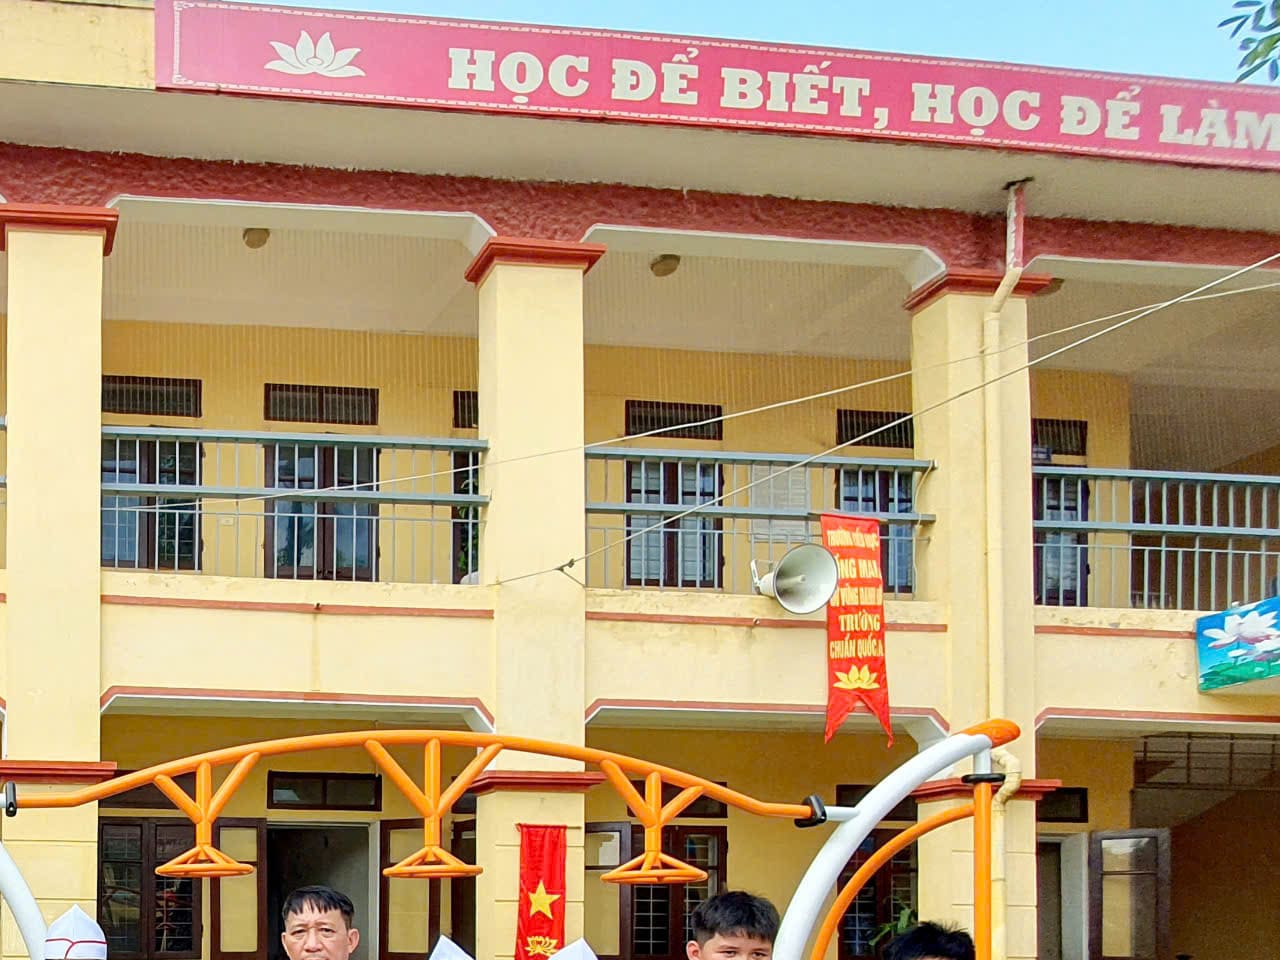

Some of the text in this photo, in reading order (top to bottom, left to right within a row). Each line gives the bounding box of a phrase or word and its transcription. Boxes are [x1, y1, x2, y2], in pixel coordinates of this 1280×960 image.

[448, 47, 1280, 151] HỌC ĐỂ BIẾT, HỌC ĐỂ LÀM
[838, 609, 880, 632] TRƯỜNG
